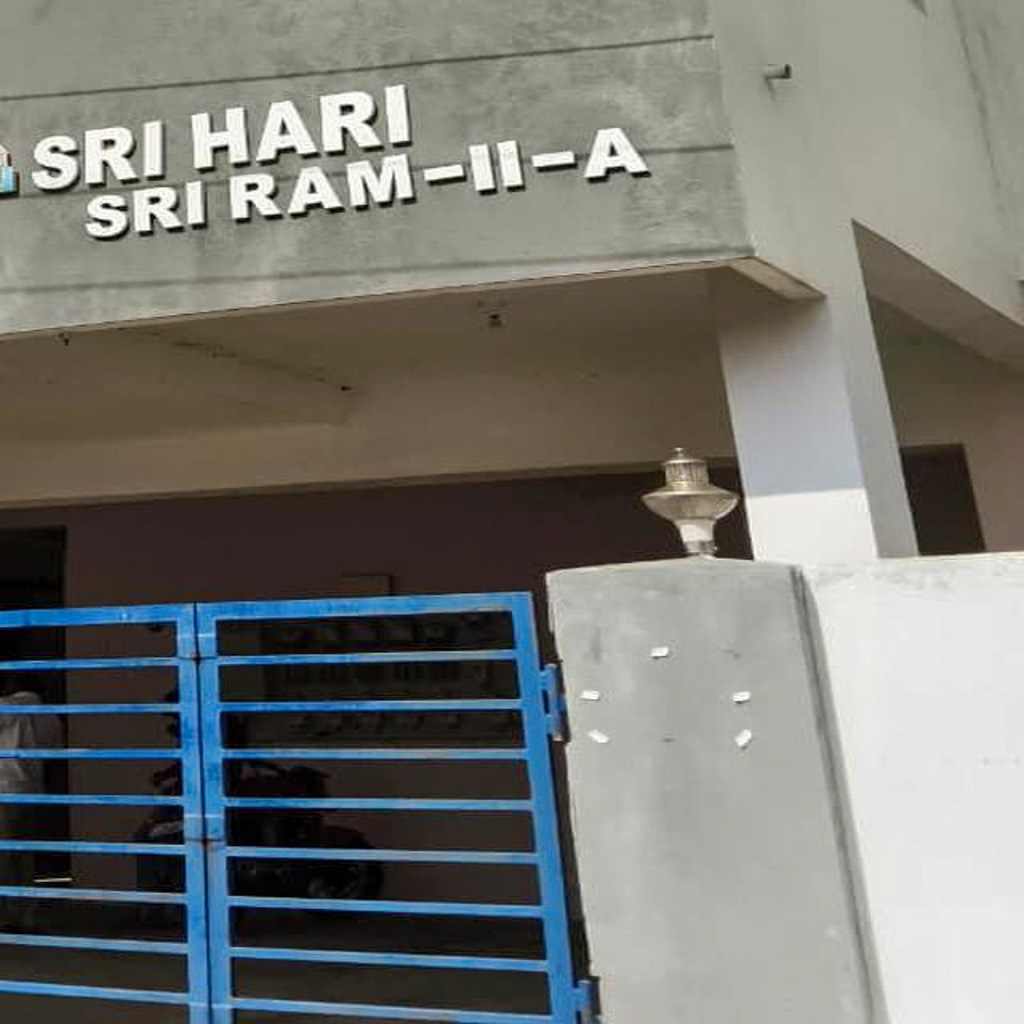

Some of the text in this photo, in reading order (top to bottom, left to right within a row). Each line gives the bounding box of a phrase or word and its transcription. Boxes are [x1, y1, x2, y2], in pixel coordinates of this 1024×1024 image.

[31, 84, 410, 191] SRI HARI
[85, 180, 205, 237] SRI
